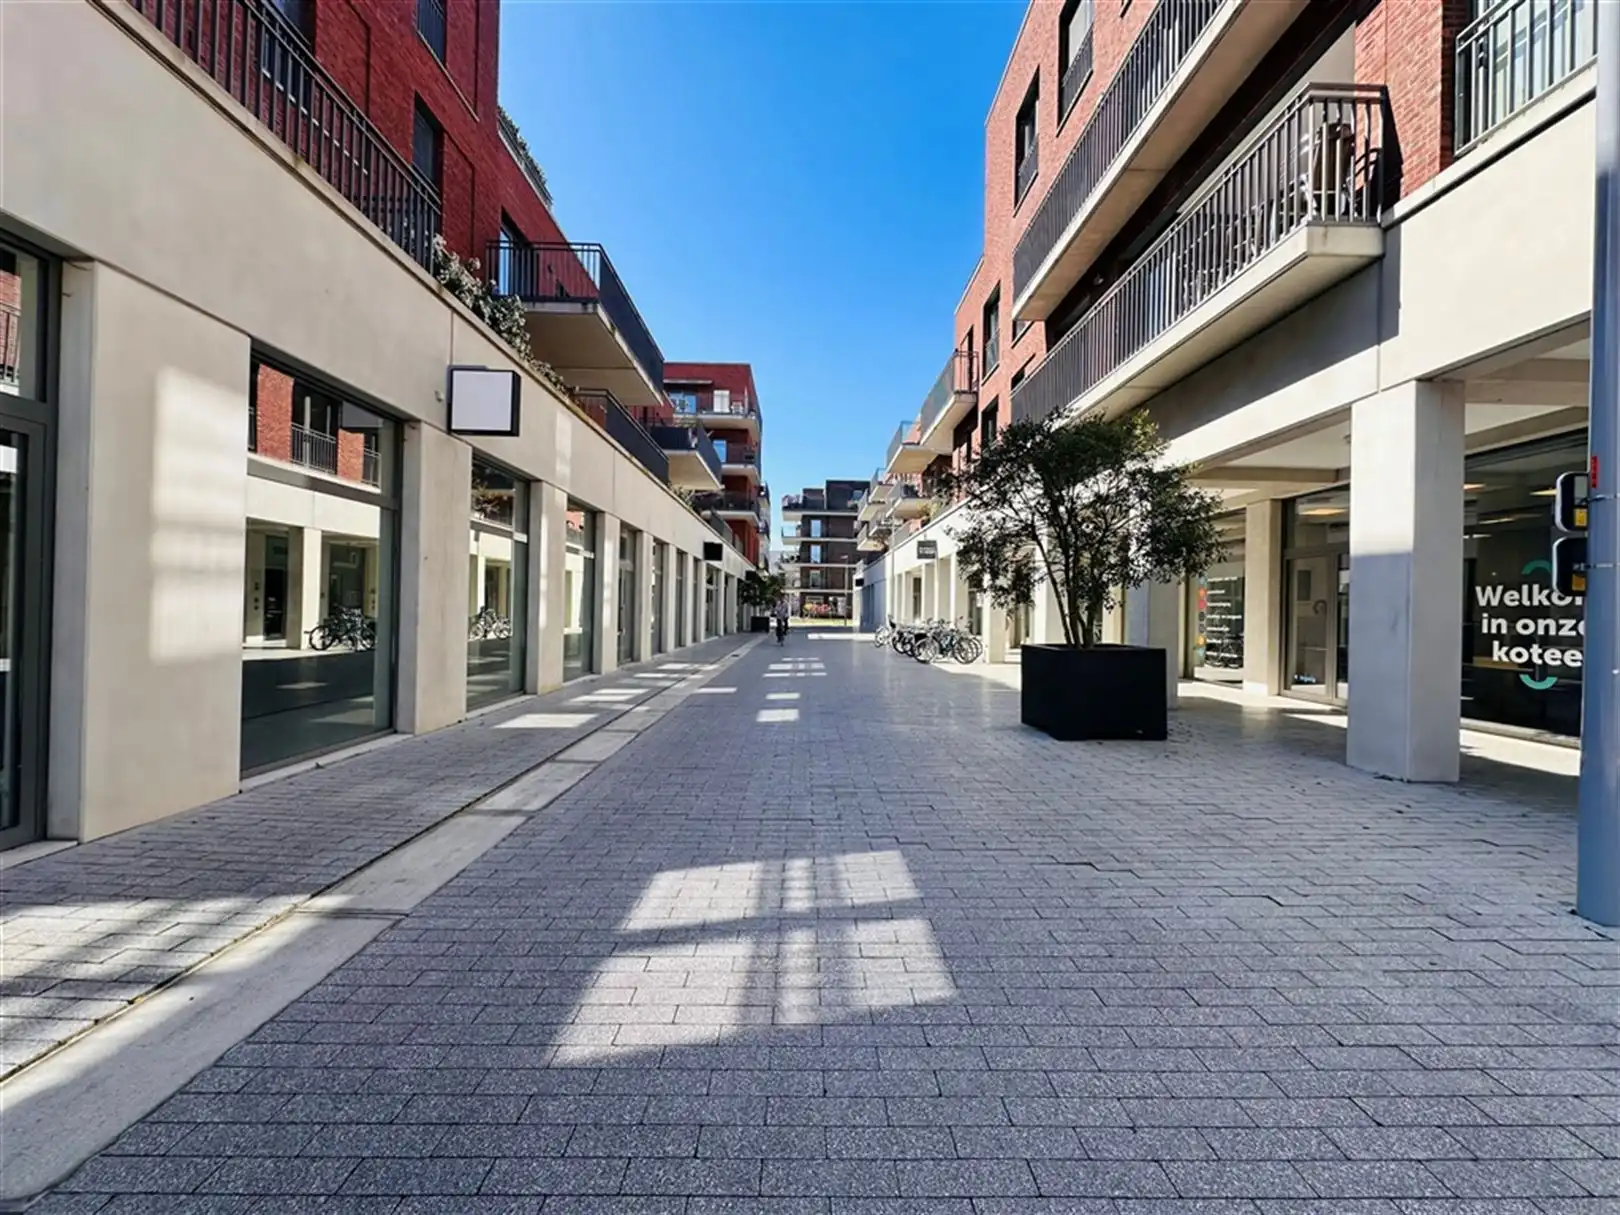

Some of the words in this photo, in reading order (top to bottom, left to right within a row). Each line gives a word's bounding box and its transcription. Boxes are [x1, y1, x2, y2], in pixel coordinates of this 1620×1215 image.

[1475, 584, 1583, 606] Welko
[1481, 613, 1507, 634] in
[1491, 640, 1583, 667] kotee
